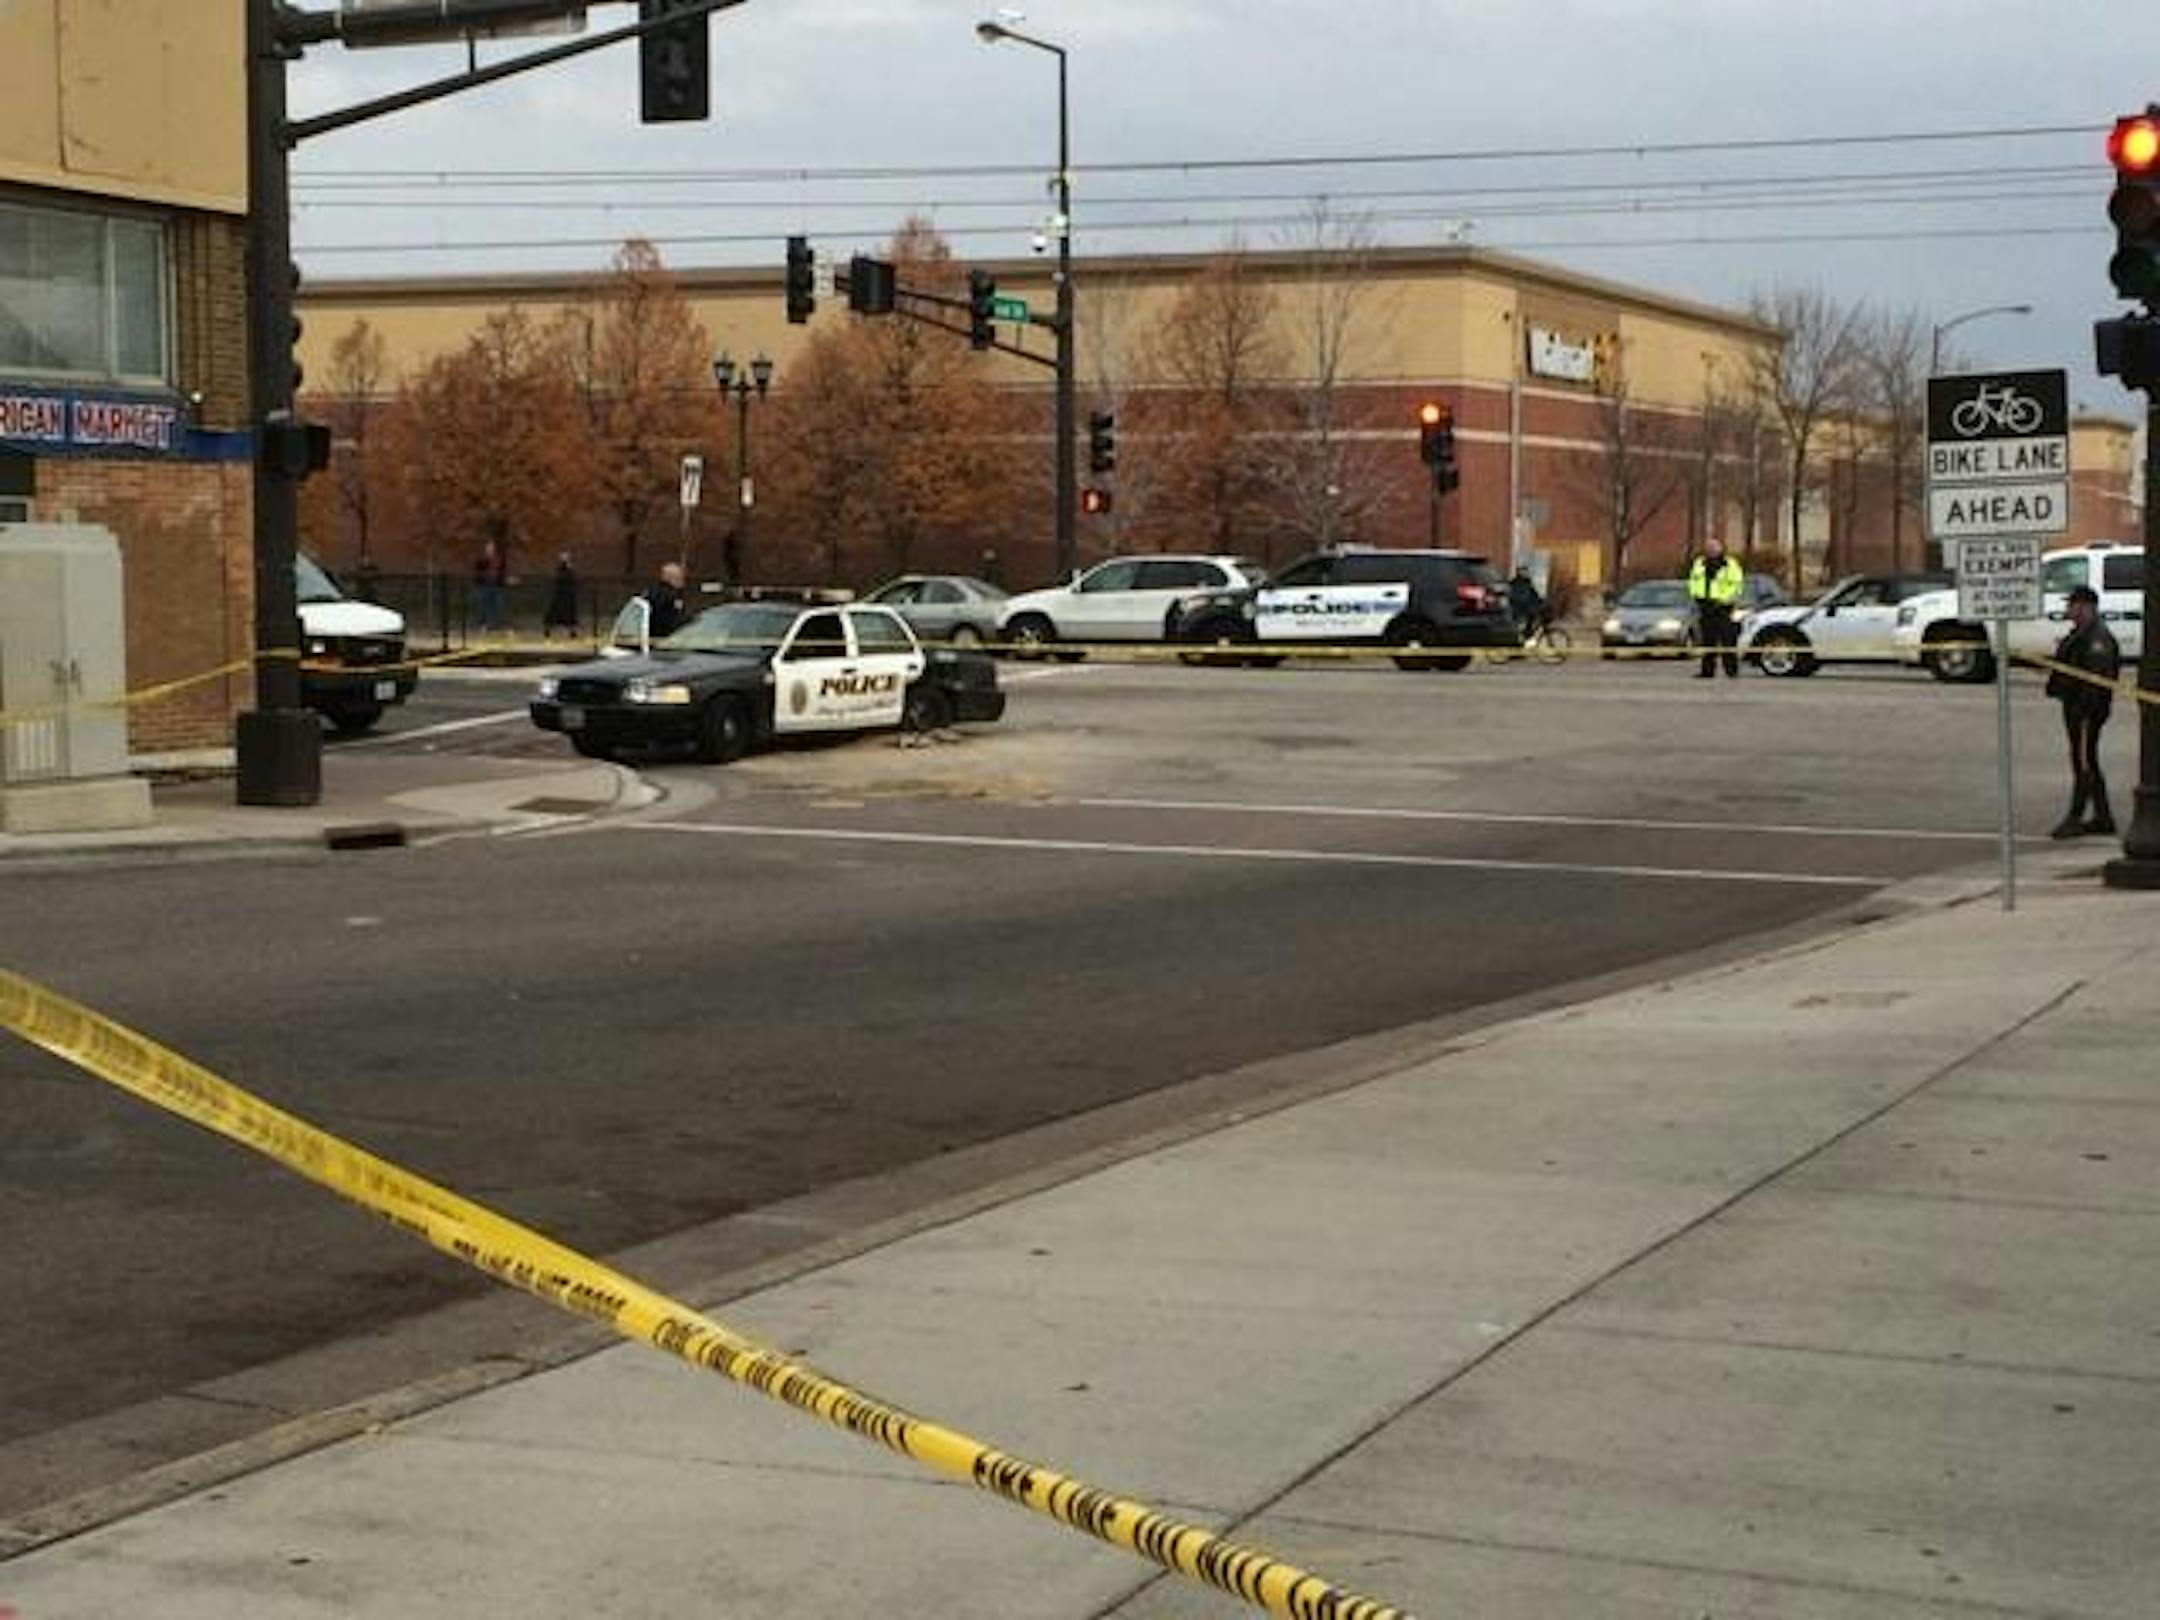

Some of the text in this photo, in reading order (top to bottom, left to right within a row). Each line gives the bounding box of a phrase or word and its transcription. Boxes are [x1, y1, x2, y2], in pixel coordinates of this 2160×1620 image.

[77, 404, 174, 447] MARKET
[1933, 442, 2063, 474] BIKE LANE
[1946, 495, 2053, 524] AHEAD
[1964, 557, 2035, 574] EXEMPT
[1271, 603, 1372, 615] POLICE
[820, 674, 898, 696] POLICE
